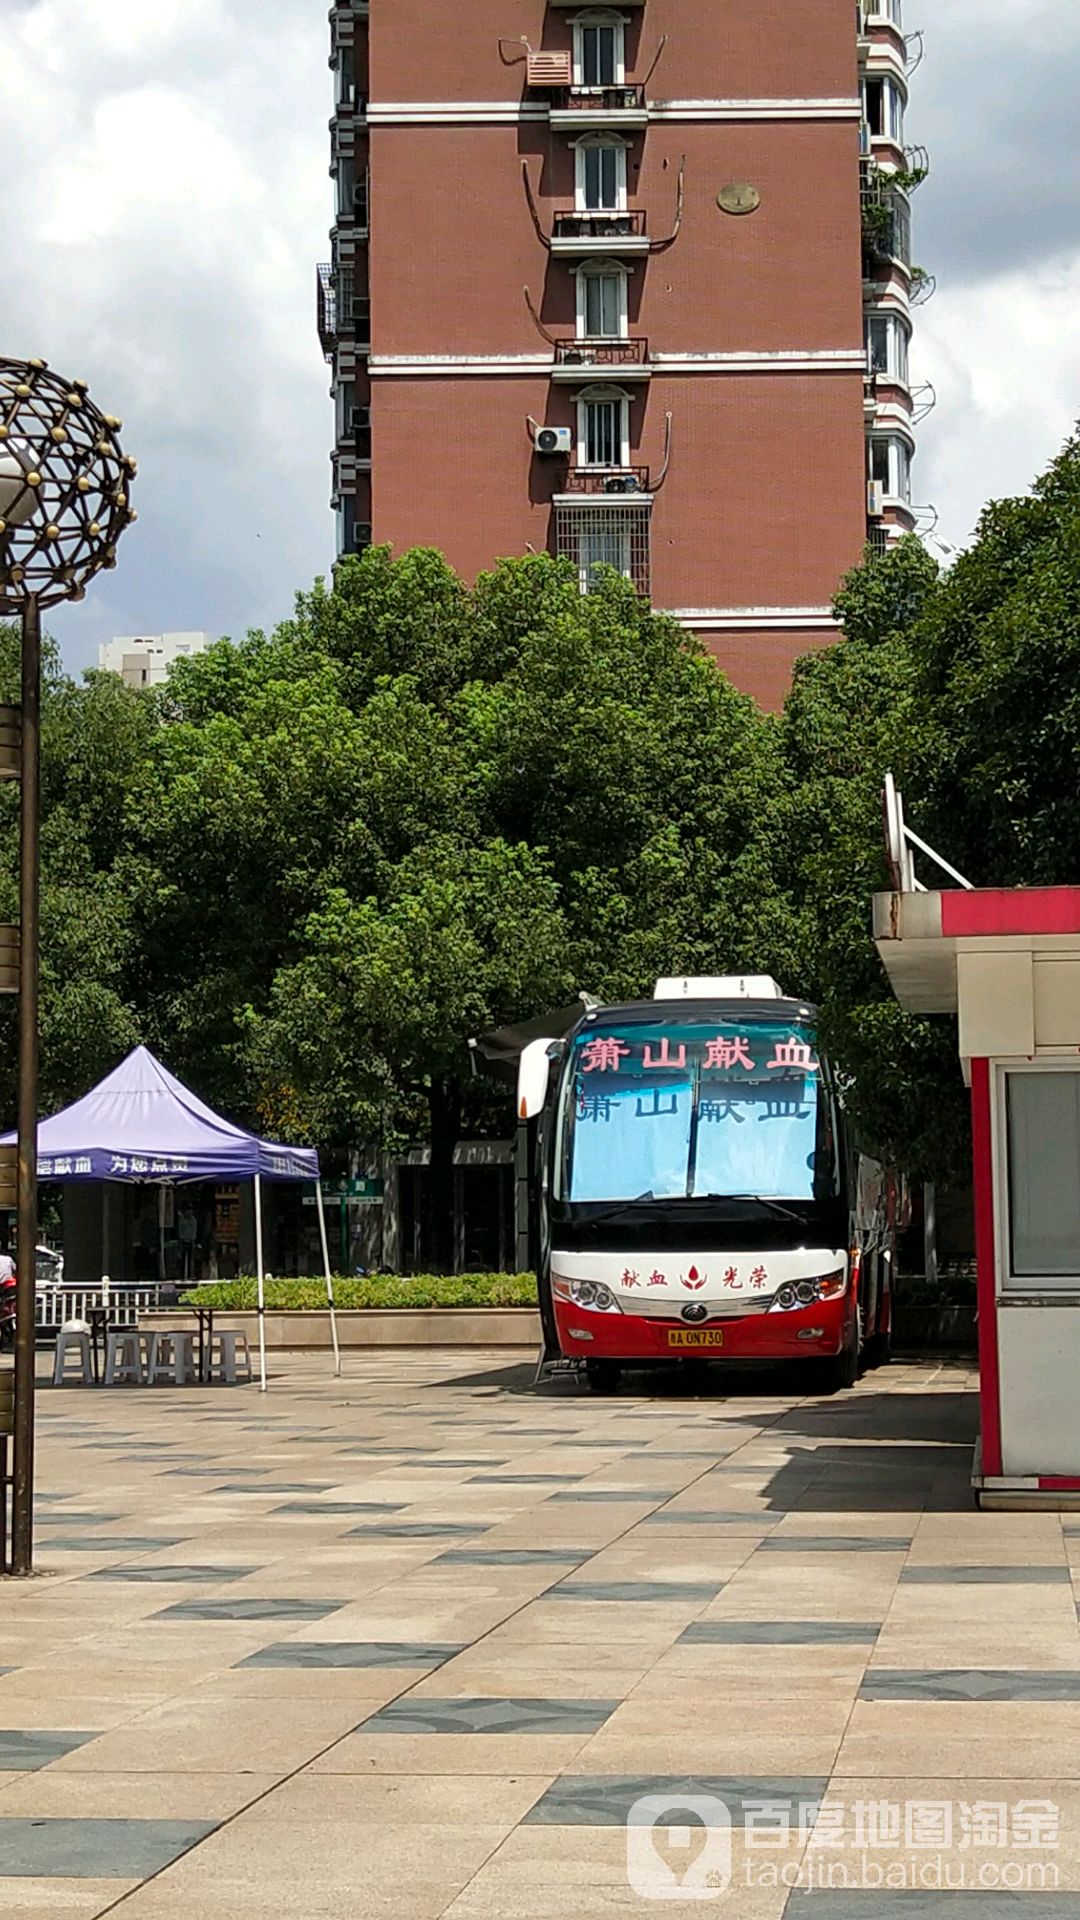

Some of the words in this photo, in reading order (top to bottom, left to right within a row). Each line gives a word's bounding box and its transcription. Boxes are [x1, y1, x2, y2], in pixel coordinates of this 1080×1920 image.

[580, 1036, 820, 1072] 萧山献血
[620, 1268, 668, 1289] 献血
[722, 1265, 768, 1289] 光荣
